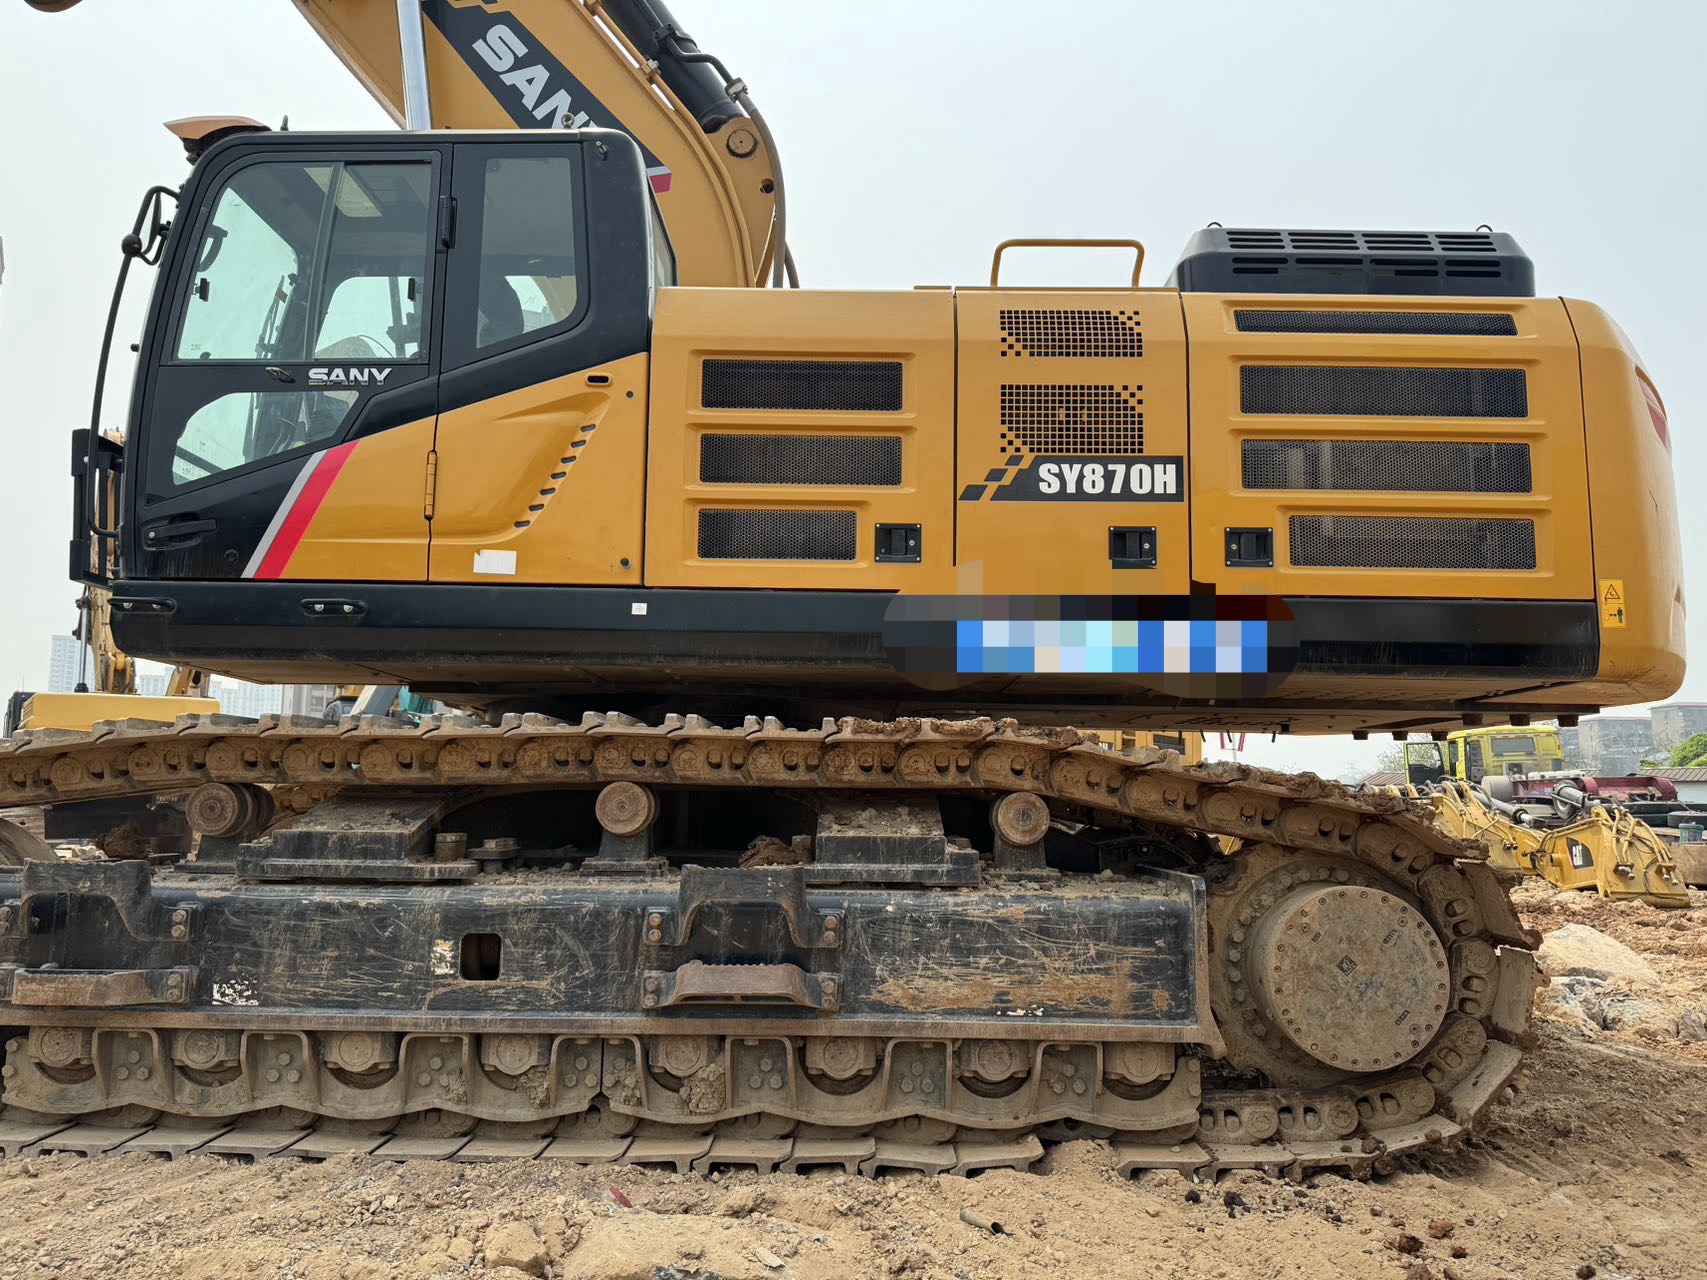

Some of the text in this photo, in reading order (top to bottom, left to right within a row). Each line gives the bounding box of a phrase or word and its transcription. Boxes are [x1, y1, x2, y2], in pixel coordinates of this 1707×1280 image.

[472, 24, 600, 129] SAN
[308, 367, 392, 385] SANY
[1038, 463, 1177, 494] SY870H
